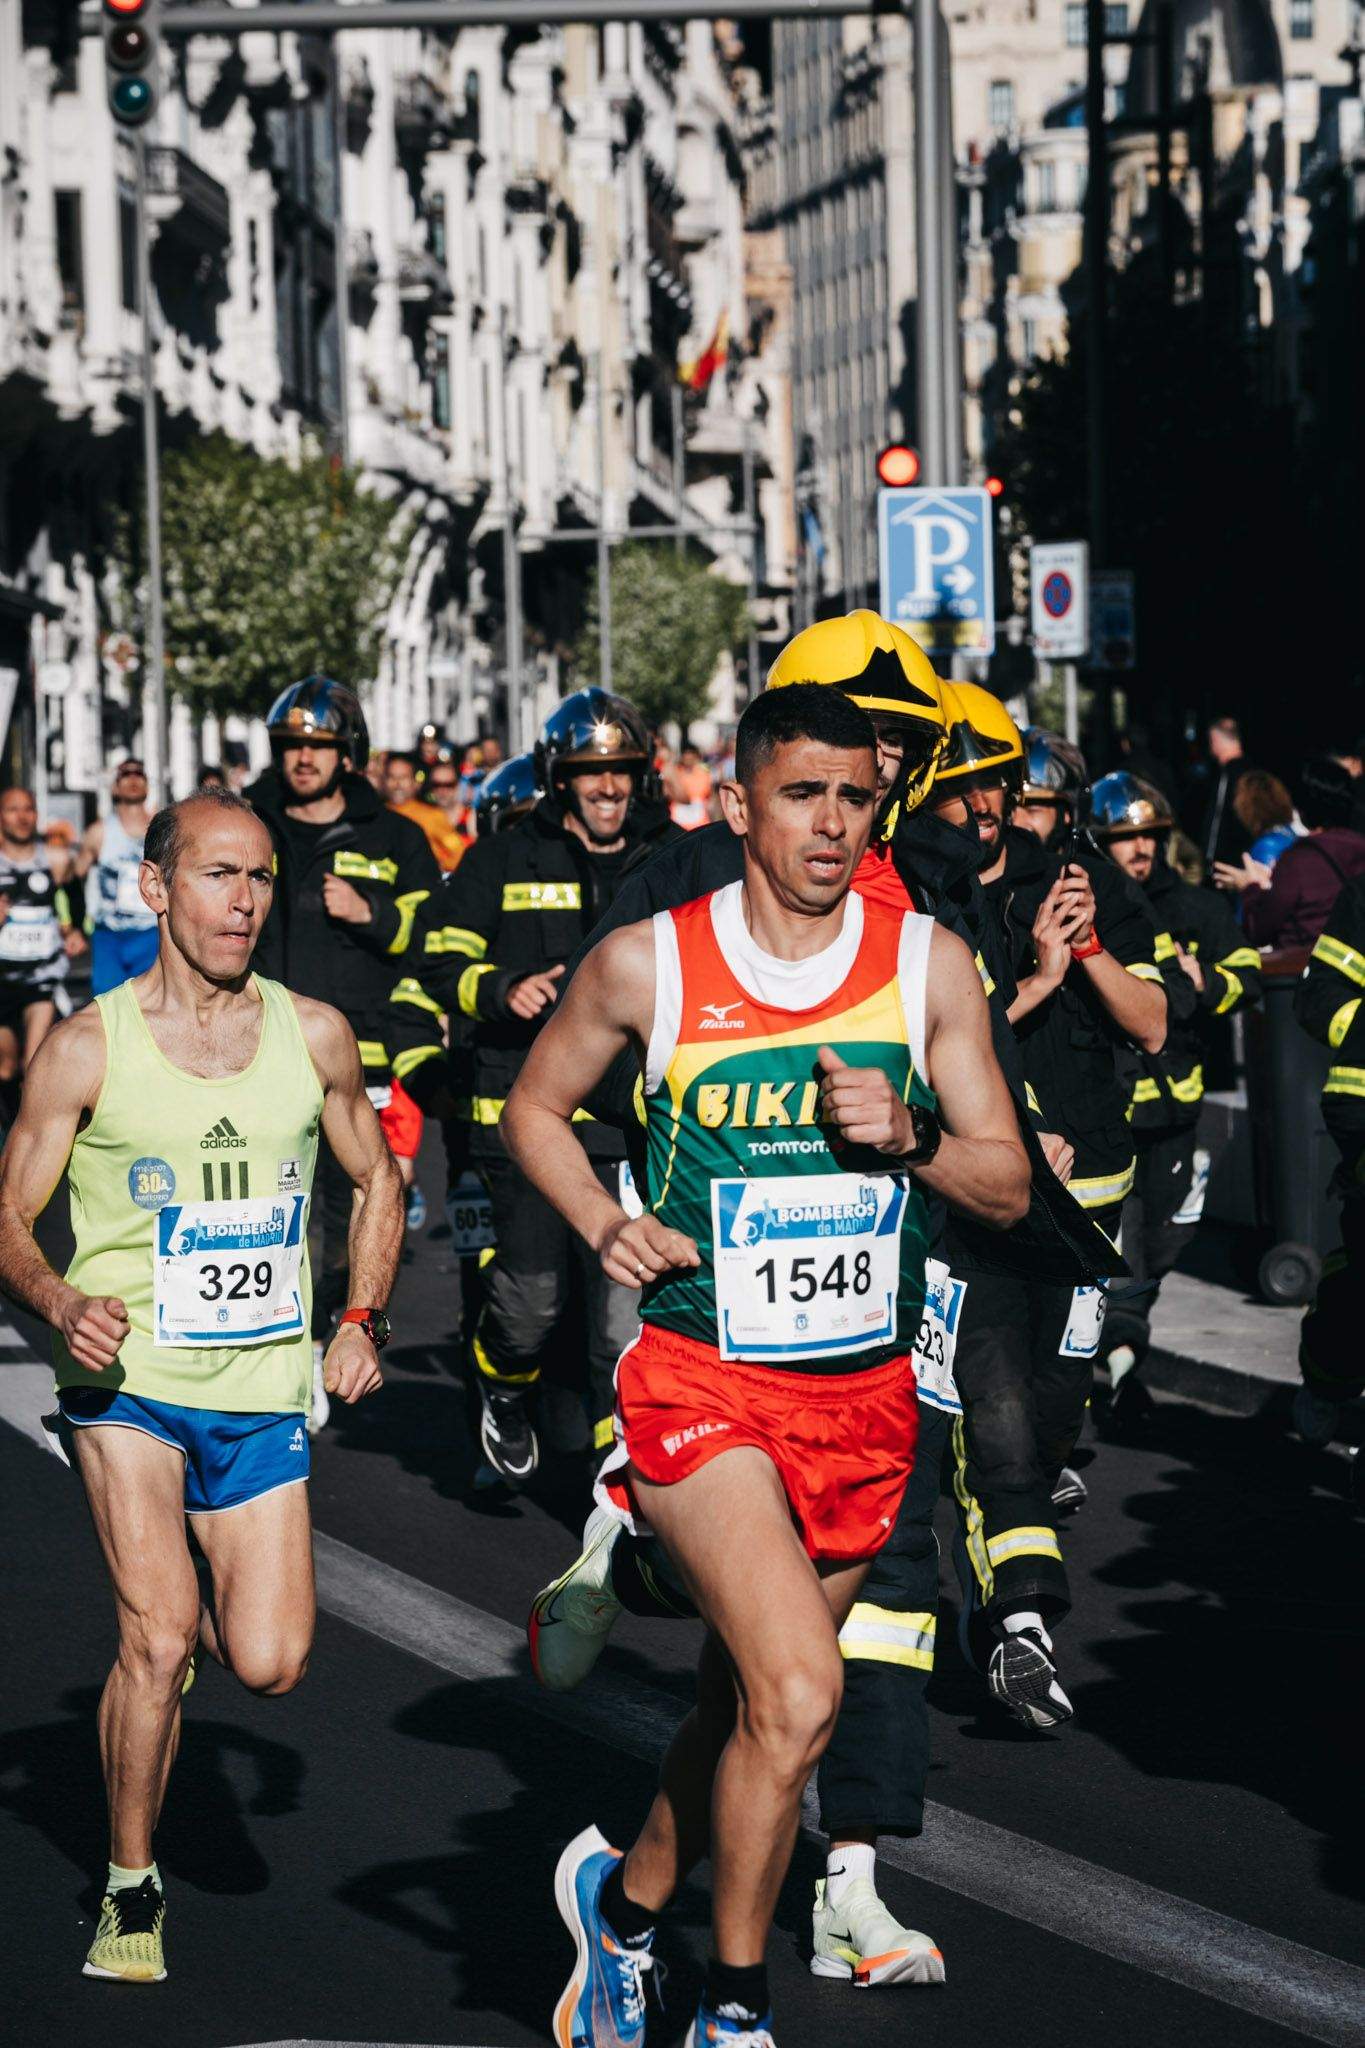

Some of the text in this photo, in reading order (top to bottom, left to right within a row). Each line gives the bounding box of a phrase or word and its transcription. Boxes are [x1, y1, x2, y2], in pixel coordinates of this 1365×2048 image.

[904, 514, 970, 600] P
[697, 1081, 824, 1129] BIKI
[200, 1136, 247, 1149] adidas
[777, 1203, 875, 1223] BOMBEROS
[206, 1220, 283, 1237] BOMBEROS
[817, 1223, 831, 1235] de
[238, 1231, 283, 1248] de MADRID
[199, 1261, 272, 1301] 329
[755, 1250, 872, 1303] 1548
